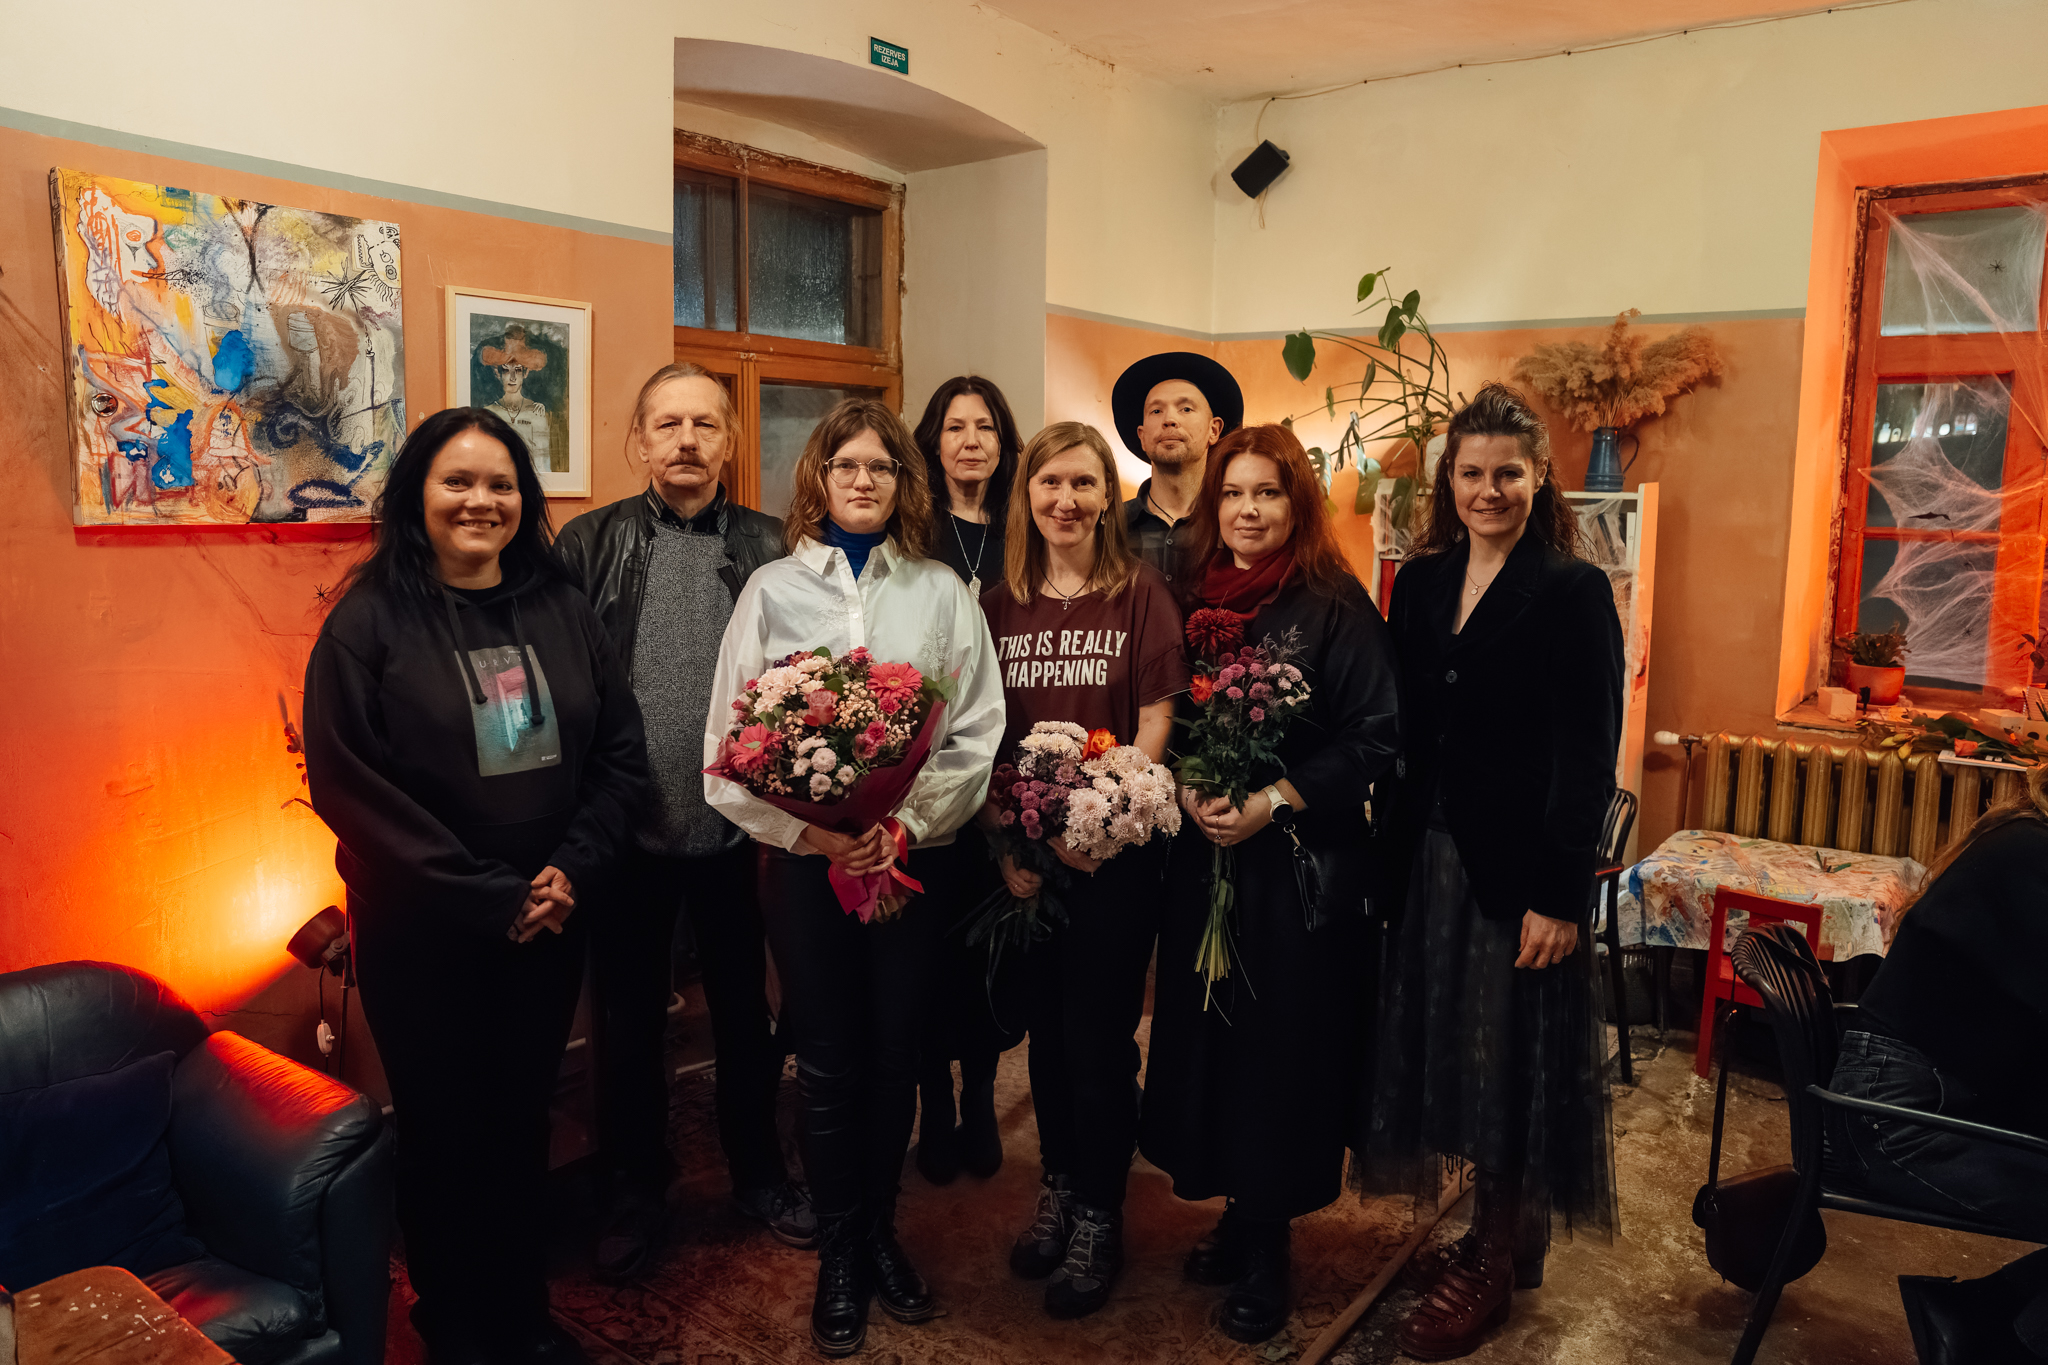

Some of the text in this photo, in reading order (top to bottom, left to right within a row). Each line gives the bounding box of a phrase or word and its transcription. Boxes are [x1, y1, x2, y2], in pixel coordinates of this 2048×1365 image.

[874, 44, 905, 61] REZERVES
[881, 55, 899, 67] IZEJA
[998, 629, 1127, 661] THIS IS REALLY
[1005, 658, 1108, 688] HAPPENING
